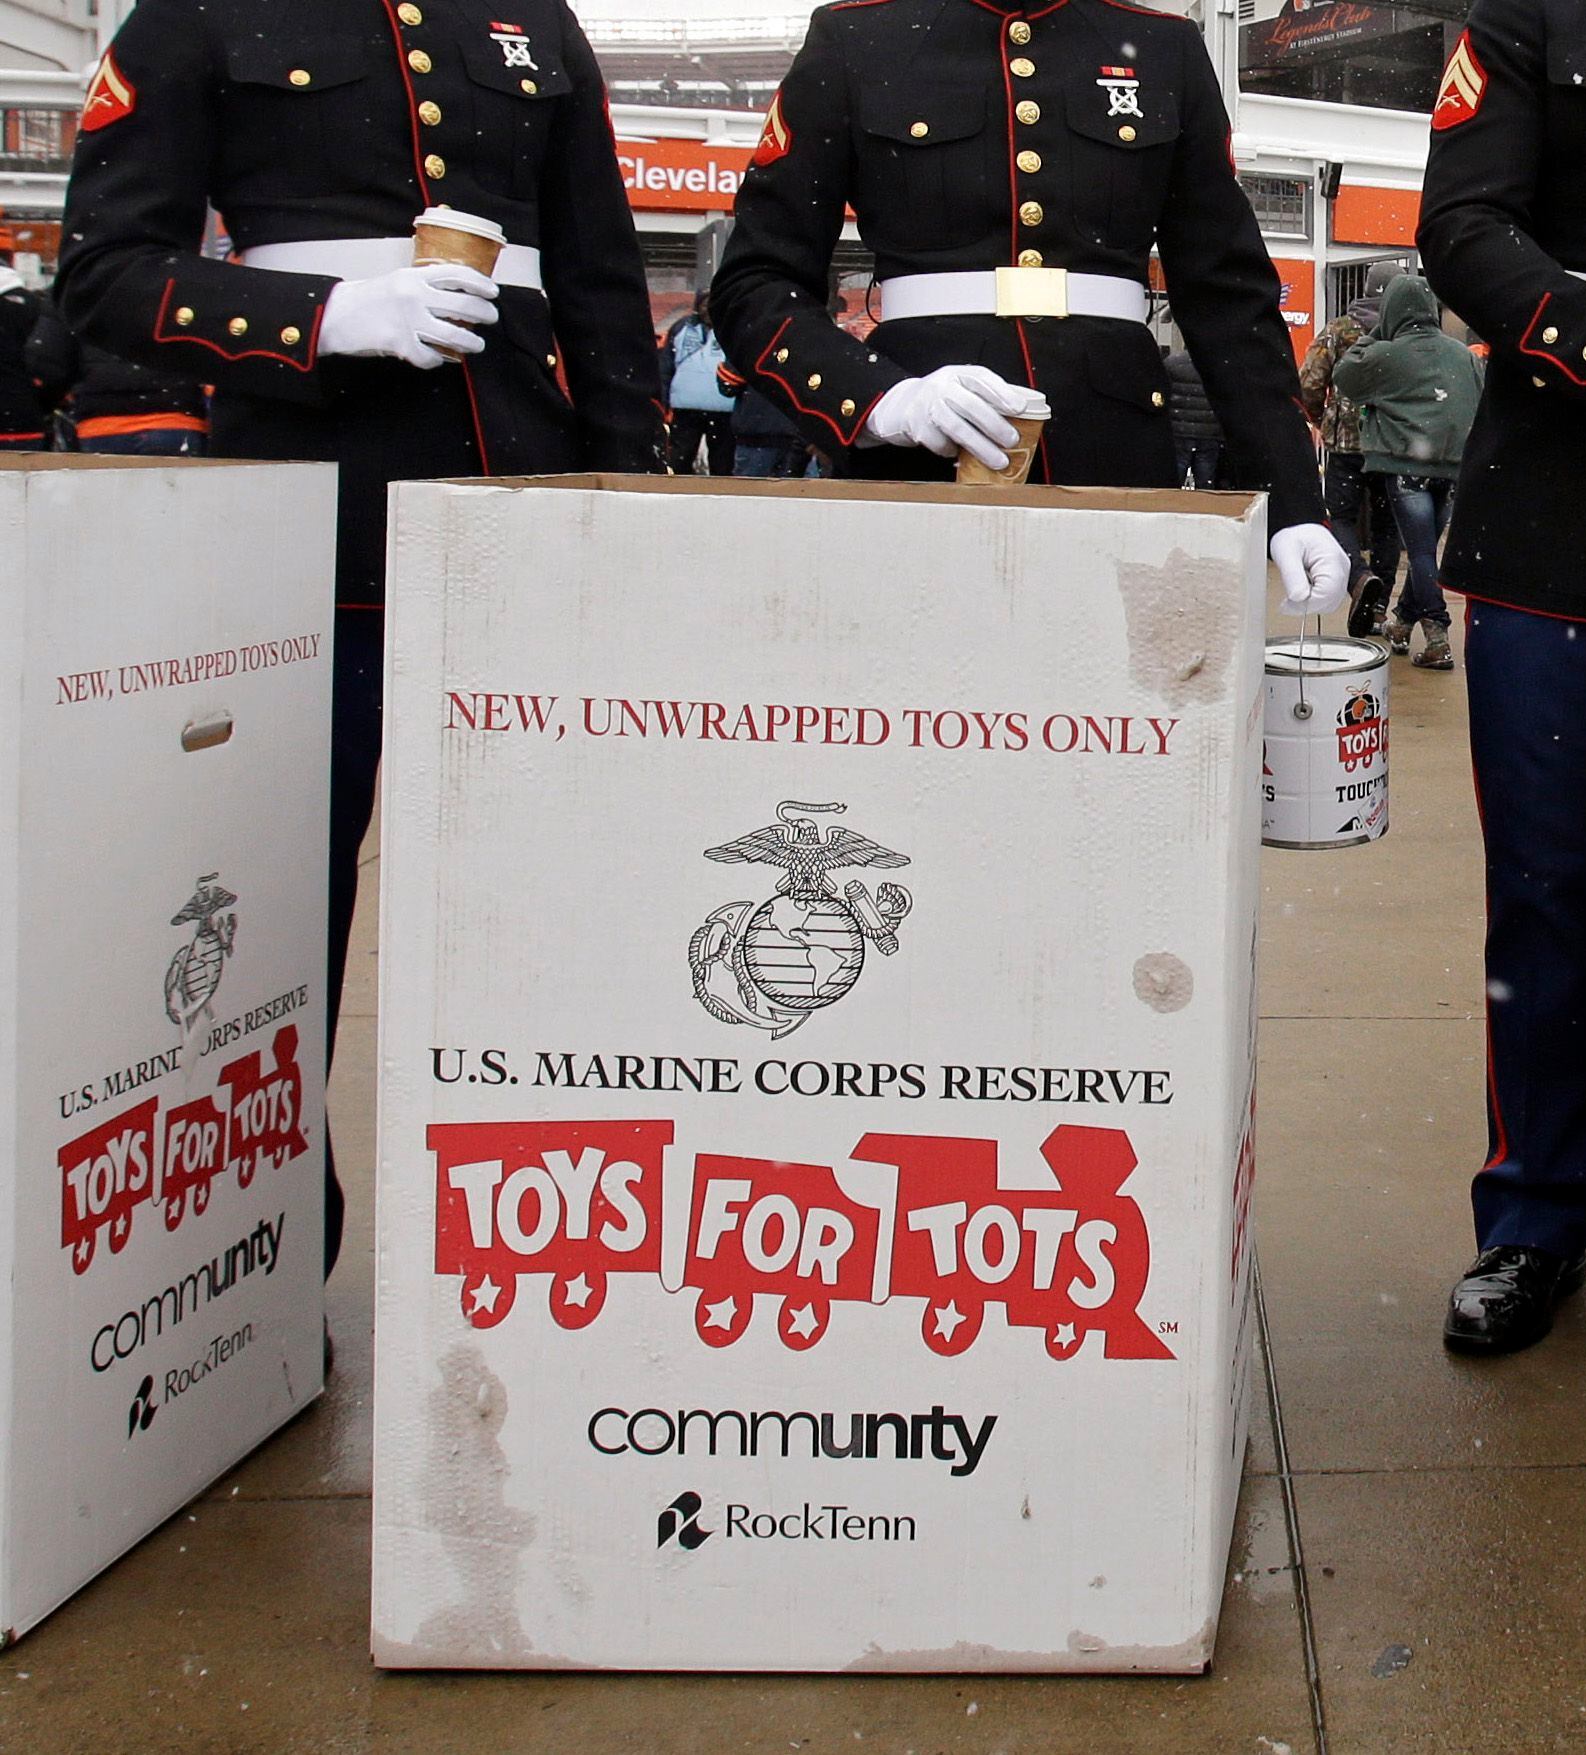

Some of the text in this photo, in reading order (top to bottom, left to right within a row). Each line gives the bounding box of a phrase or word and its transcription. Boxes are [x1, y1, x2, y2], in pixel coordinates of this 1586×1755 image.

[56, 633, 321, 705] NEW, UNWRAPPED TOYS ONLY
[444, 692, 1180, 756] NEW, UNWRAPPED TOYS ONLY
[1341, 727, 1378, 754] TOYS
[59, 1084, 98, 1118] U.S.
[243, 984, 308, 1035] RESERVE
[430, 1048, 1174, 1105] U.S. MARINE CORPS RESERVE
[67, 1079, 293, 1221] TOYS FOR TOTS
[448, 1146, 1179, 1334] TOYS FOR TOTS SM
[91, 1211, 285, 1373] community
[165, 1322, 252, 1404] RockTenn
[588, 1406, 998, 1477] community
[726, 1503, 916, 1541] RockTenn
